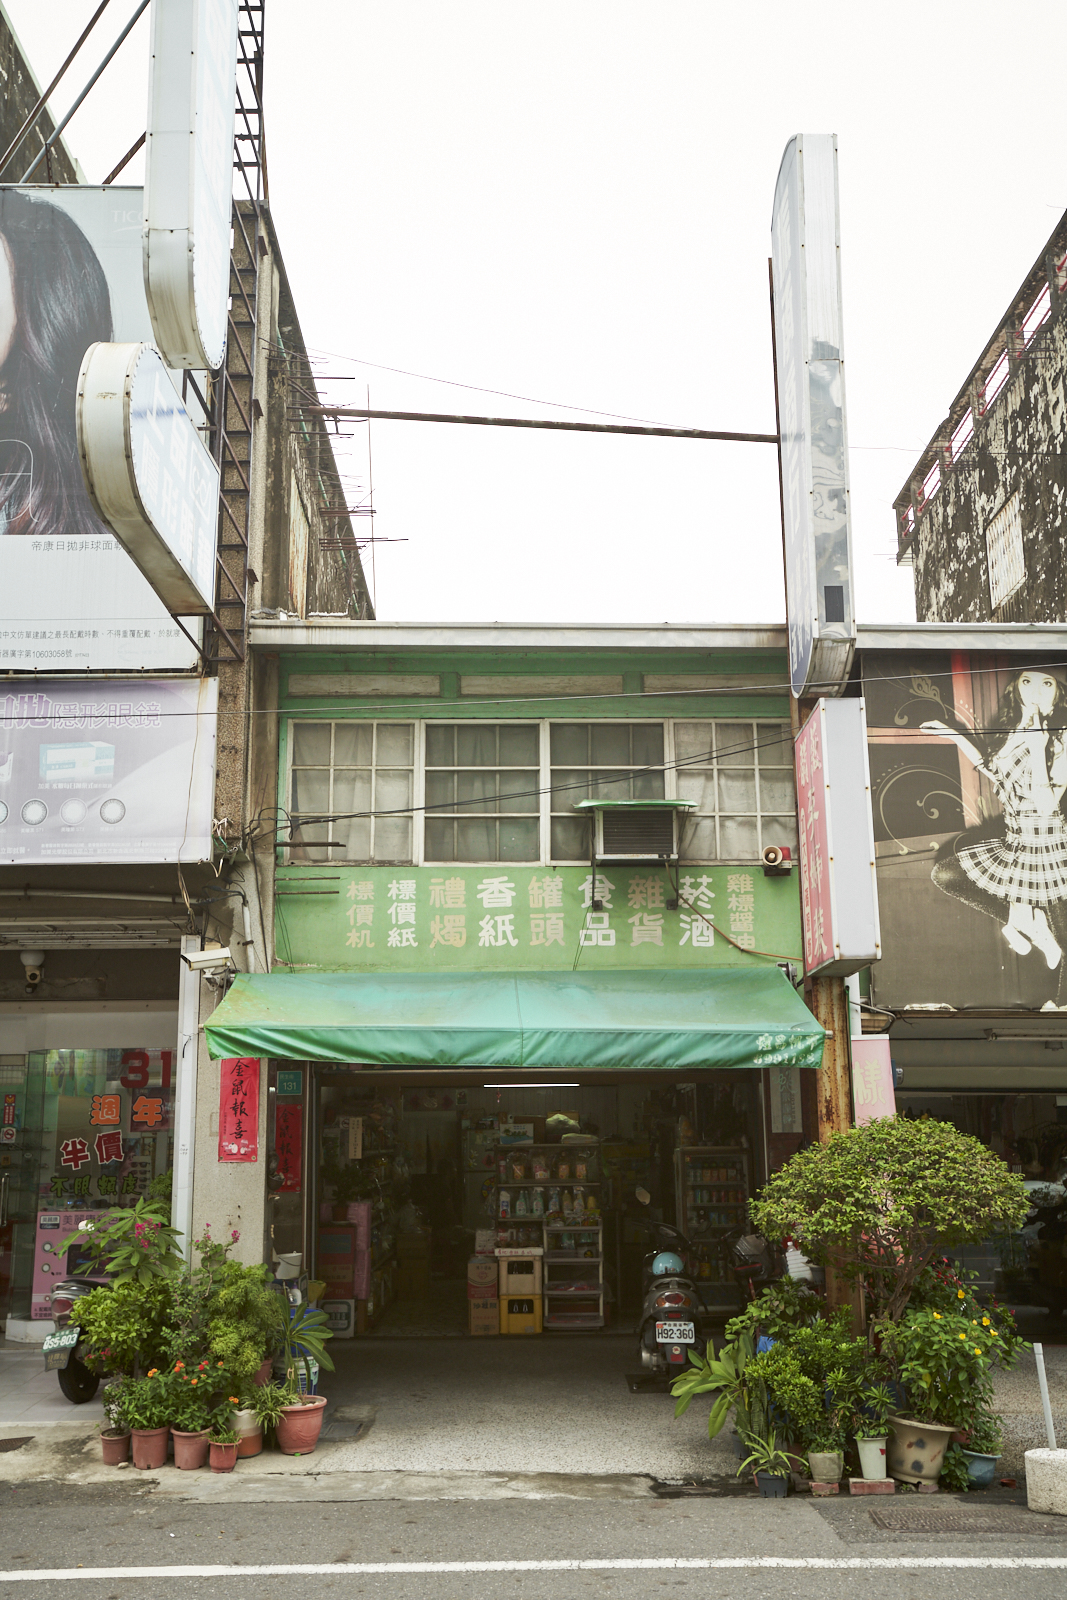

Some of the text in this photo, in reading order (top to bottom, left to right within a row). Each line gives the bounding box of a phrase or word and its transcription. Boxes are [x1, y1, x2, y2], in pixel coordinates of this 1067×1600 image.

[387, 879, 419, 948] 標價紙
[429, 876, 467, 948] 禮燭
[476, 875, 519, 947] 香紙
[528, 875, 566, 947] 罐頭
[578, 874, 616, 947] 食品
[627, 875, 665, 947] 雜貨
[120, 1051, 172, 1088] 31
[229, 1059, 250, 1140] 金鼠報喜
[282, 1082, 297, 1091] 131
[51, 1174, 142, 1197] 不限額度
[60, 1129, 125, 1170] 半價
